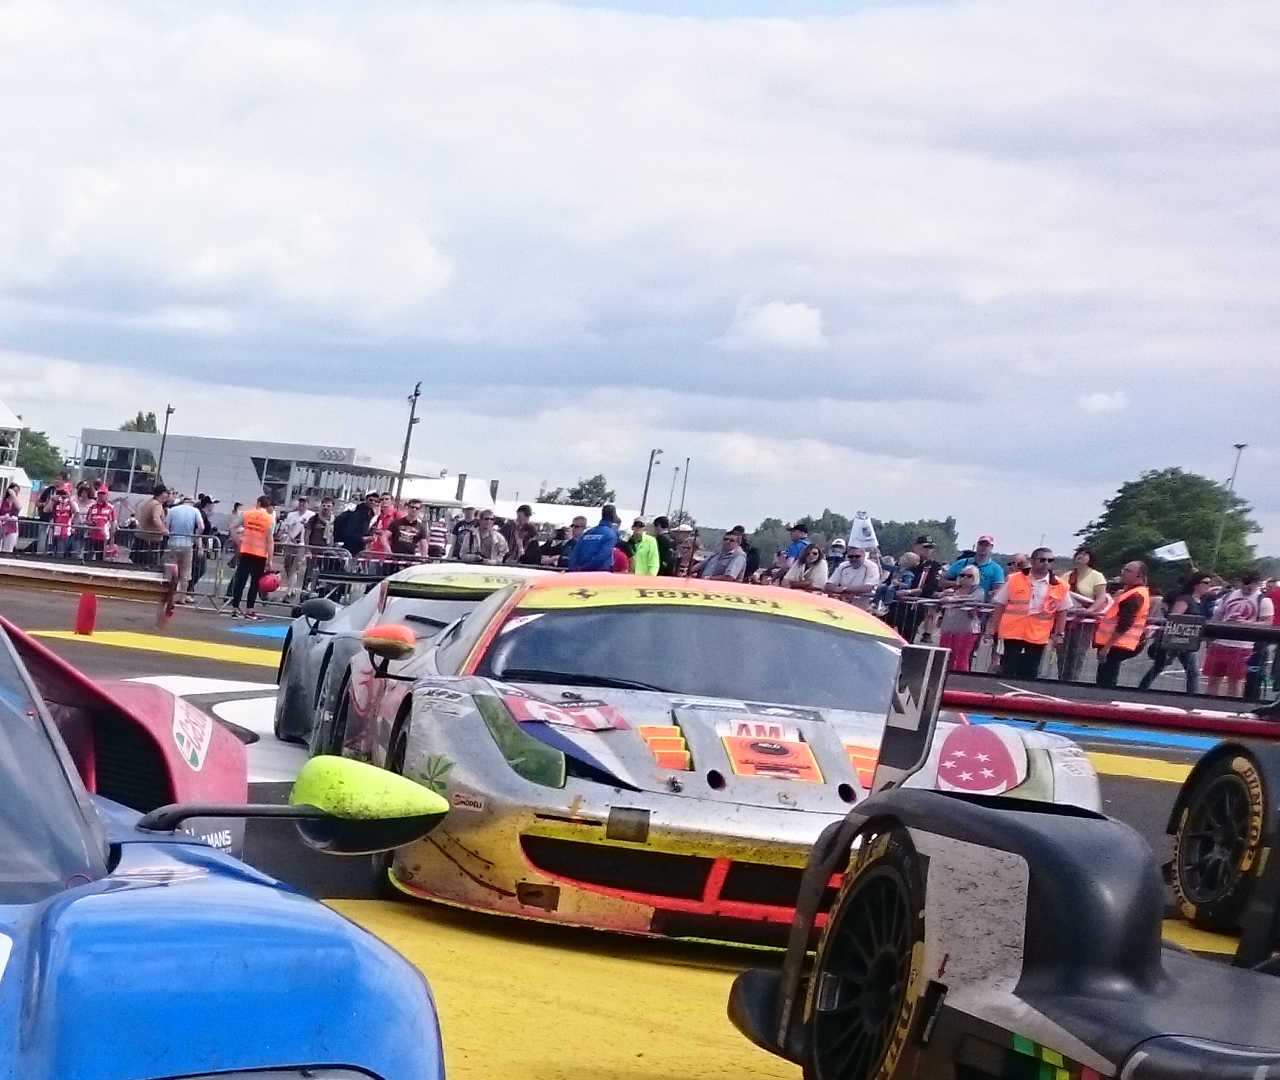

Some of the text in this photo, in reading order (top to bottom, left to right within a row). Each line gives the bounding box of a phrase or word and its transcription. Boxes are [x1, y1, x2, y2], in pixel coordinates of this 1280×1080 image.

[635, 588, 783, 609] Ferrari
[524, 700, 617, 730] 61
[737, 723, 781, 739] AM
[207, 830, 231, 848] MANS
